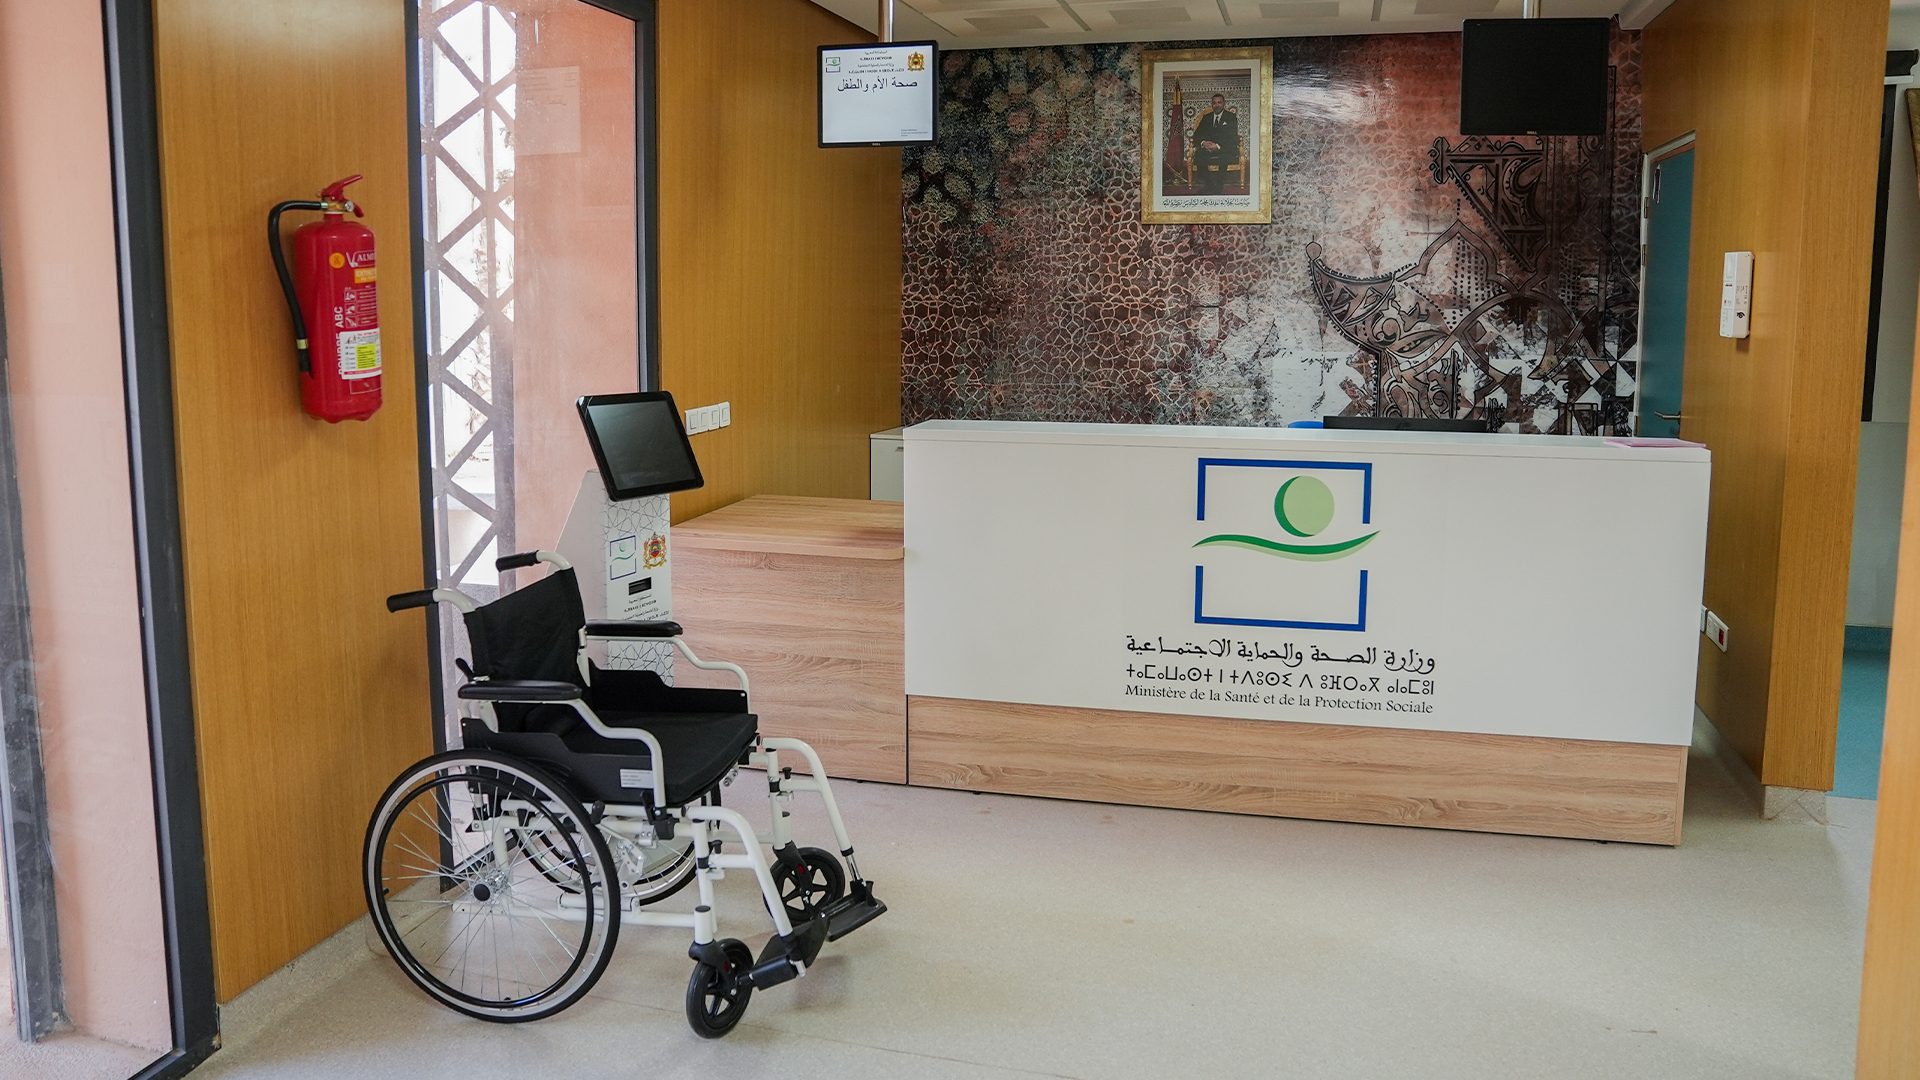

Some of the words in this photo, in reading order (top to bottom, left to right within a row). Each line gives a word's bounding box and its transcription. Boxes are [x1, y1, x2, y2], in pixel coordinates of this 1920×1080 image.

[837, 78, 869, 92] والطفل
[872, 75, 888, 93] الأم
[891, 76, 918, 88] صحة
[333, 306, 344, 328] ABC
[1126, 635, 1231, 658] الاجتماعية
[1237, 641, 1304, 668] والحماية
[1310, 645, 1377, 667] الصحة
[1384, 648, 1436, 675] وزارة
[1125, 684, 1187, 699] Ministère
[1189, 688, 1206, 701] de
[1209, 689, 1221, 701] la
[1225, 690, 1260, 704] Santé
[1263, 693, 1276, 705] et
[1279, 693, 1295, 706] de
[1299, 694, 1311, 707] la
[1315, 695, 1382, 711] Protection
[1386, 699, 1434, 714] Sociale
